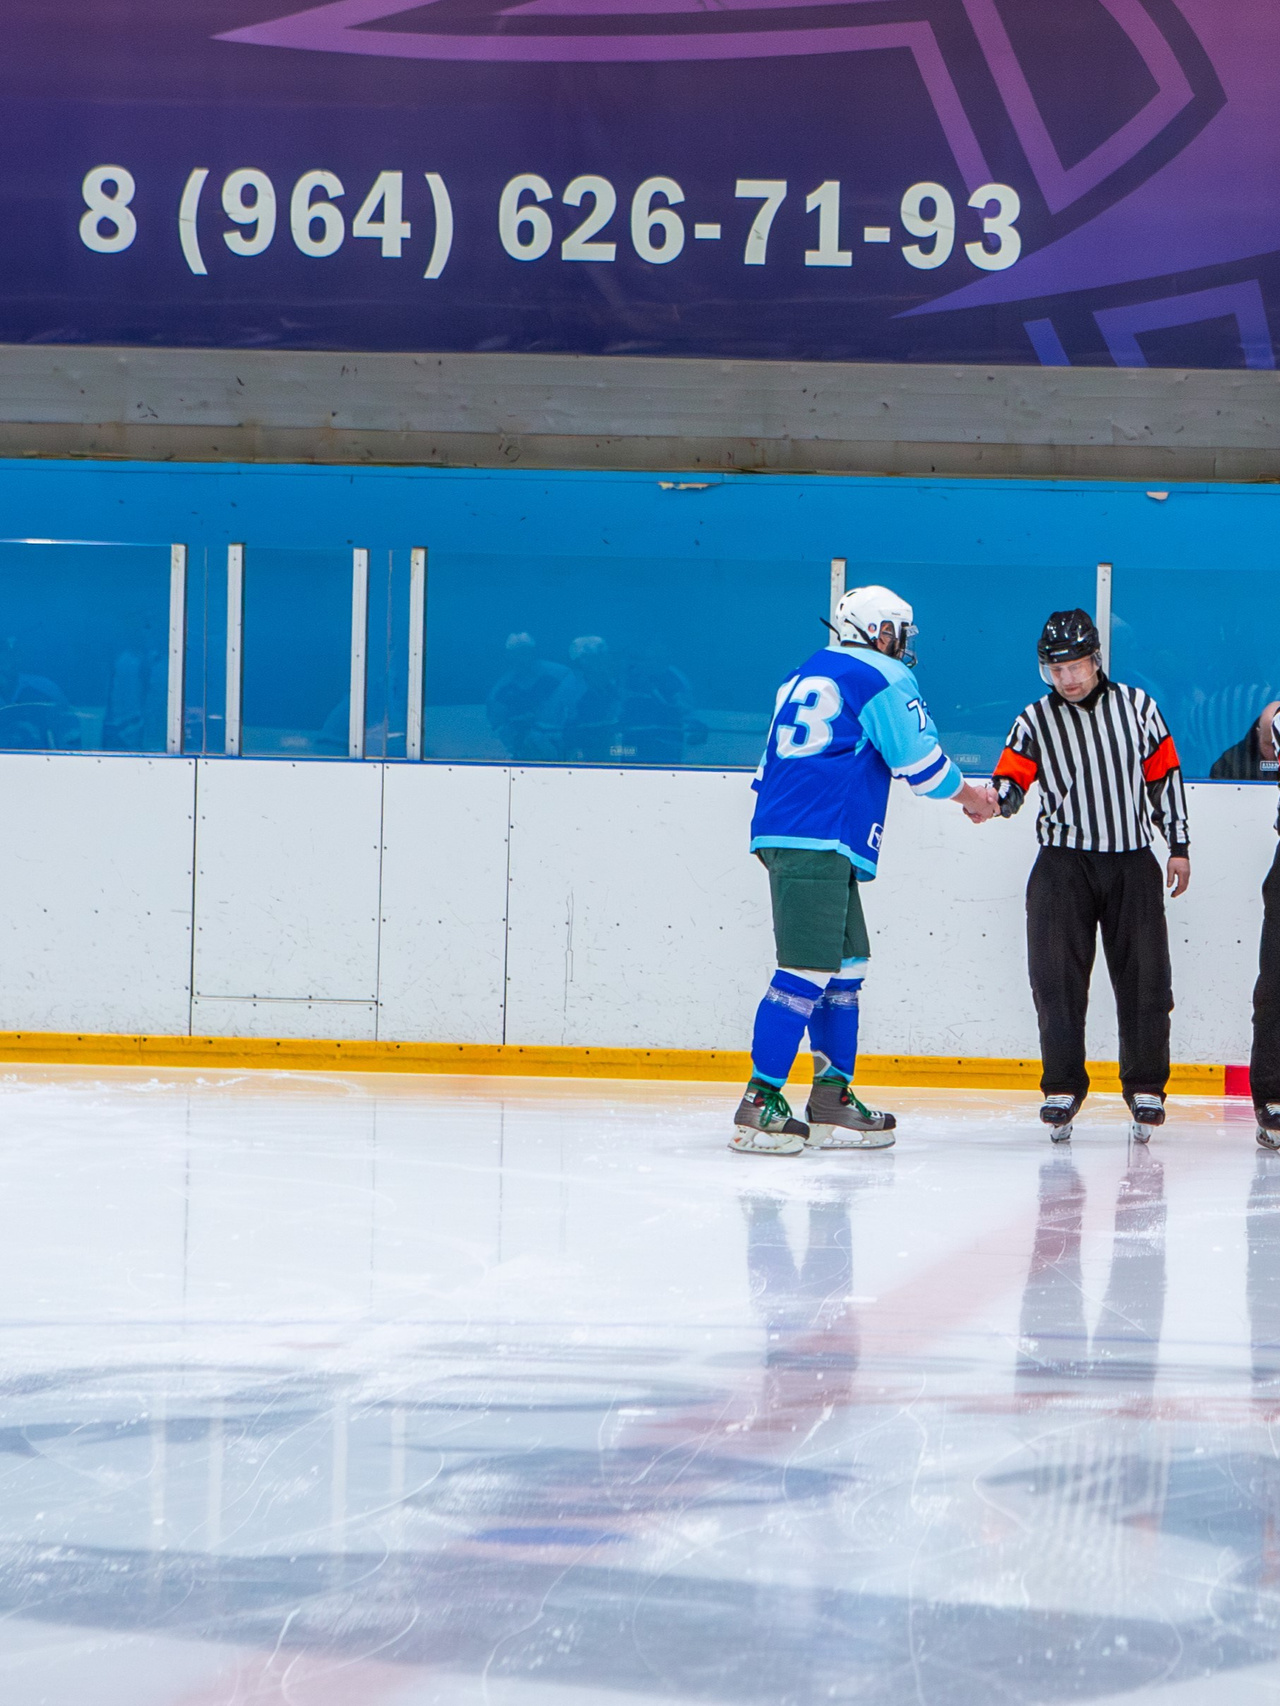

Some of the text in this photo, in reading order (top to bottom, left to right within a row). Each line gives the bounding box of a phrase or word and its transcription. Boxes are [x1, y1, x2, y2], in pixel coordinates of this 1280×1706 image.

[79, 166, 1021, 279] 8 (964) 626-71-93
